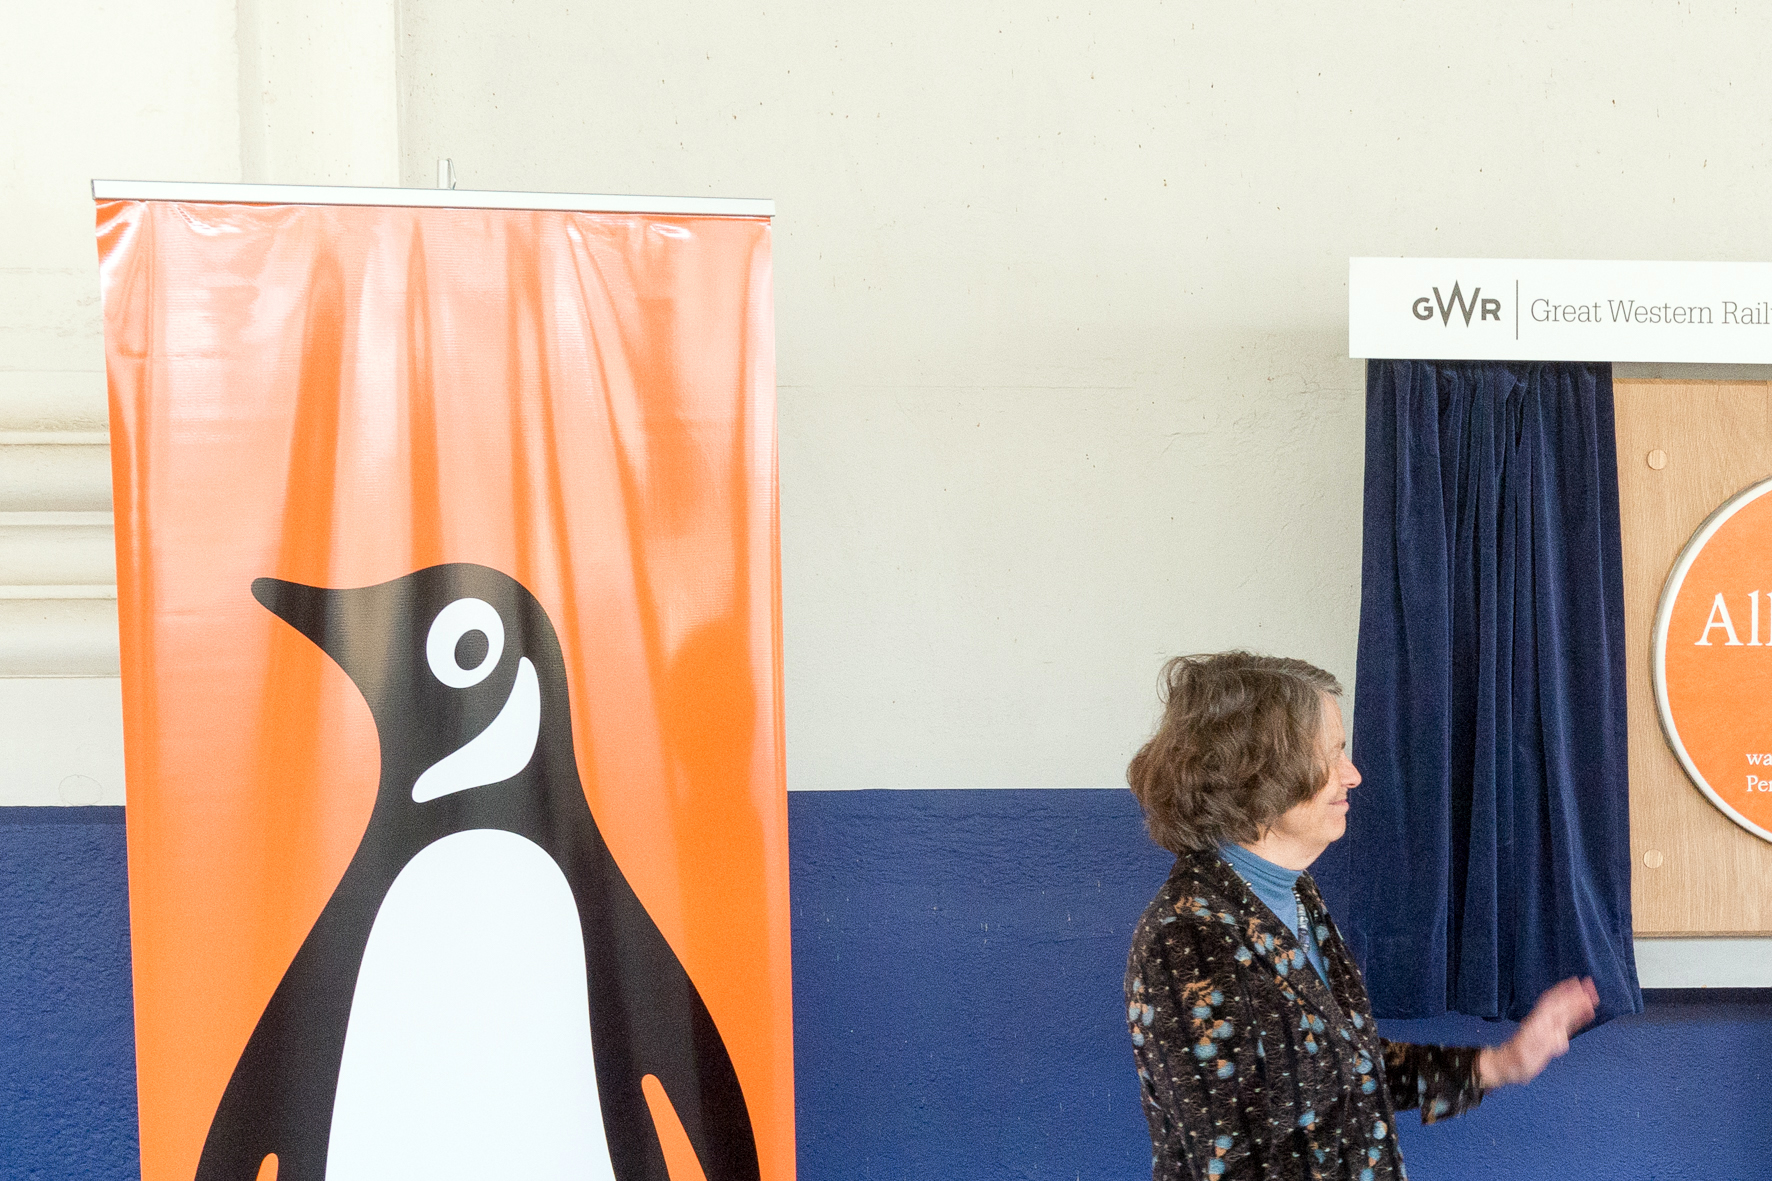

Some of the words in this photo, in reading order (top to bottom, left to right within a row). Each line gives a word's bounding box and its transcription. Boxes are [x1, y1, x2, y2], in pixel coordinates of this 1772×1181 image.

[1412, 279, 1501, 328] GWR
[1530, 298, 1602, 323] Great
[1607, 299, 1714, 325] Western
